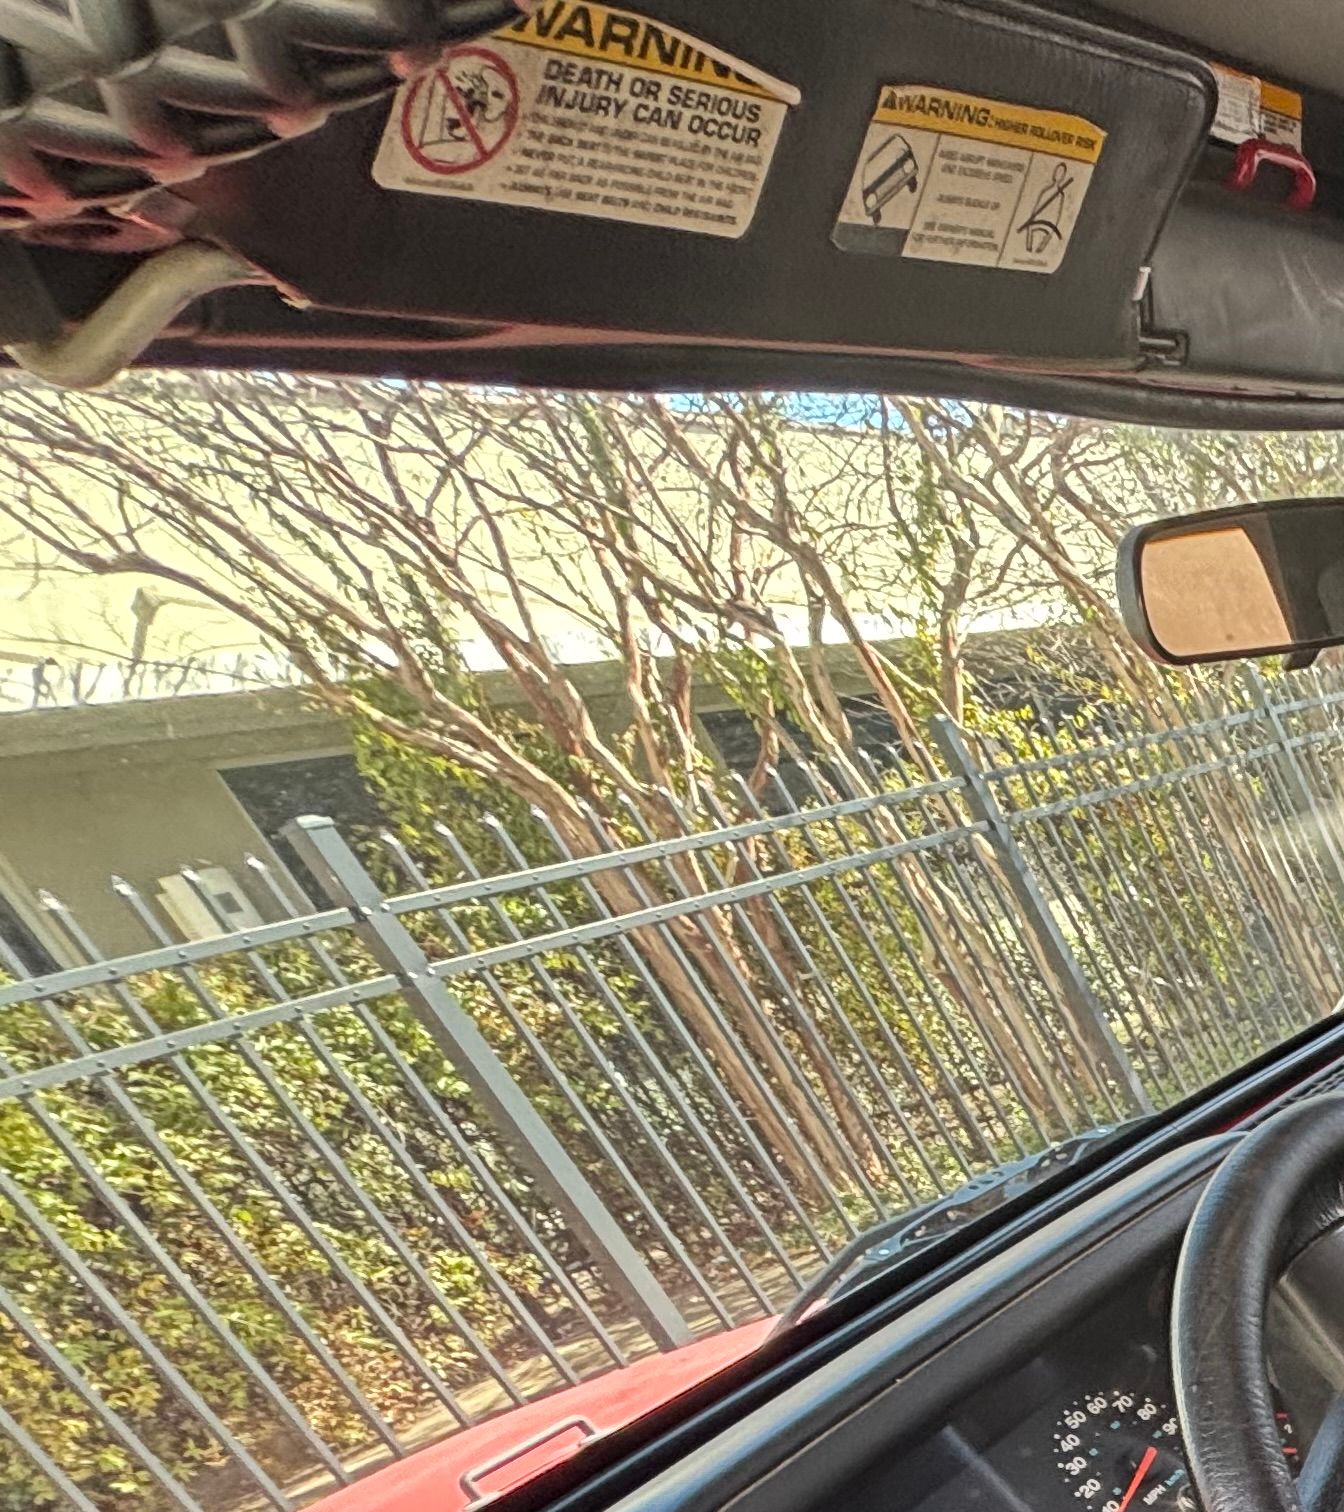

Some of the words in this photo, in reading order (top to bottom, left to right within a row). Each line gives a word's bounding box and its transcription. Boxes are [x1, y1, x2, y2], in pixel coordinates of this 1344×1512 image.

[511, 2, 760, 85] WARNIN
[544, 60, 624, 92] DEATH
[630, 77, 661, 101] OR
[668, 85, 761, 123] SERIOUS
[536, 84, 628, 120] INJURY
[633, 103, 683, 131] CAN
[688, 115, 761, 148] OCCUR
[1087, 1397, 1107, 1414] 60
[1112, 1395, 1133, 1413] 70
[1137, 1403, 1157, 1420] 80
[1065, 1411, 1086, 1429] 50
[1061, 1434, 1081, 1452] 40
[1066, 1457, 1087, 1475] 30
[1079, 1478, 1100, 1499] 20
